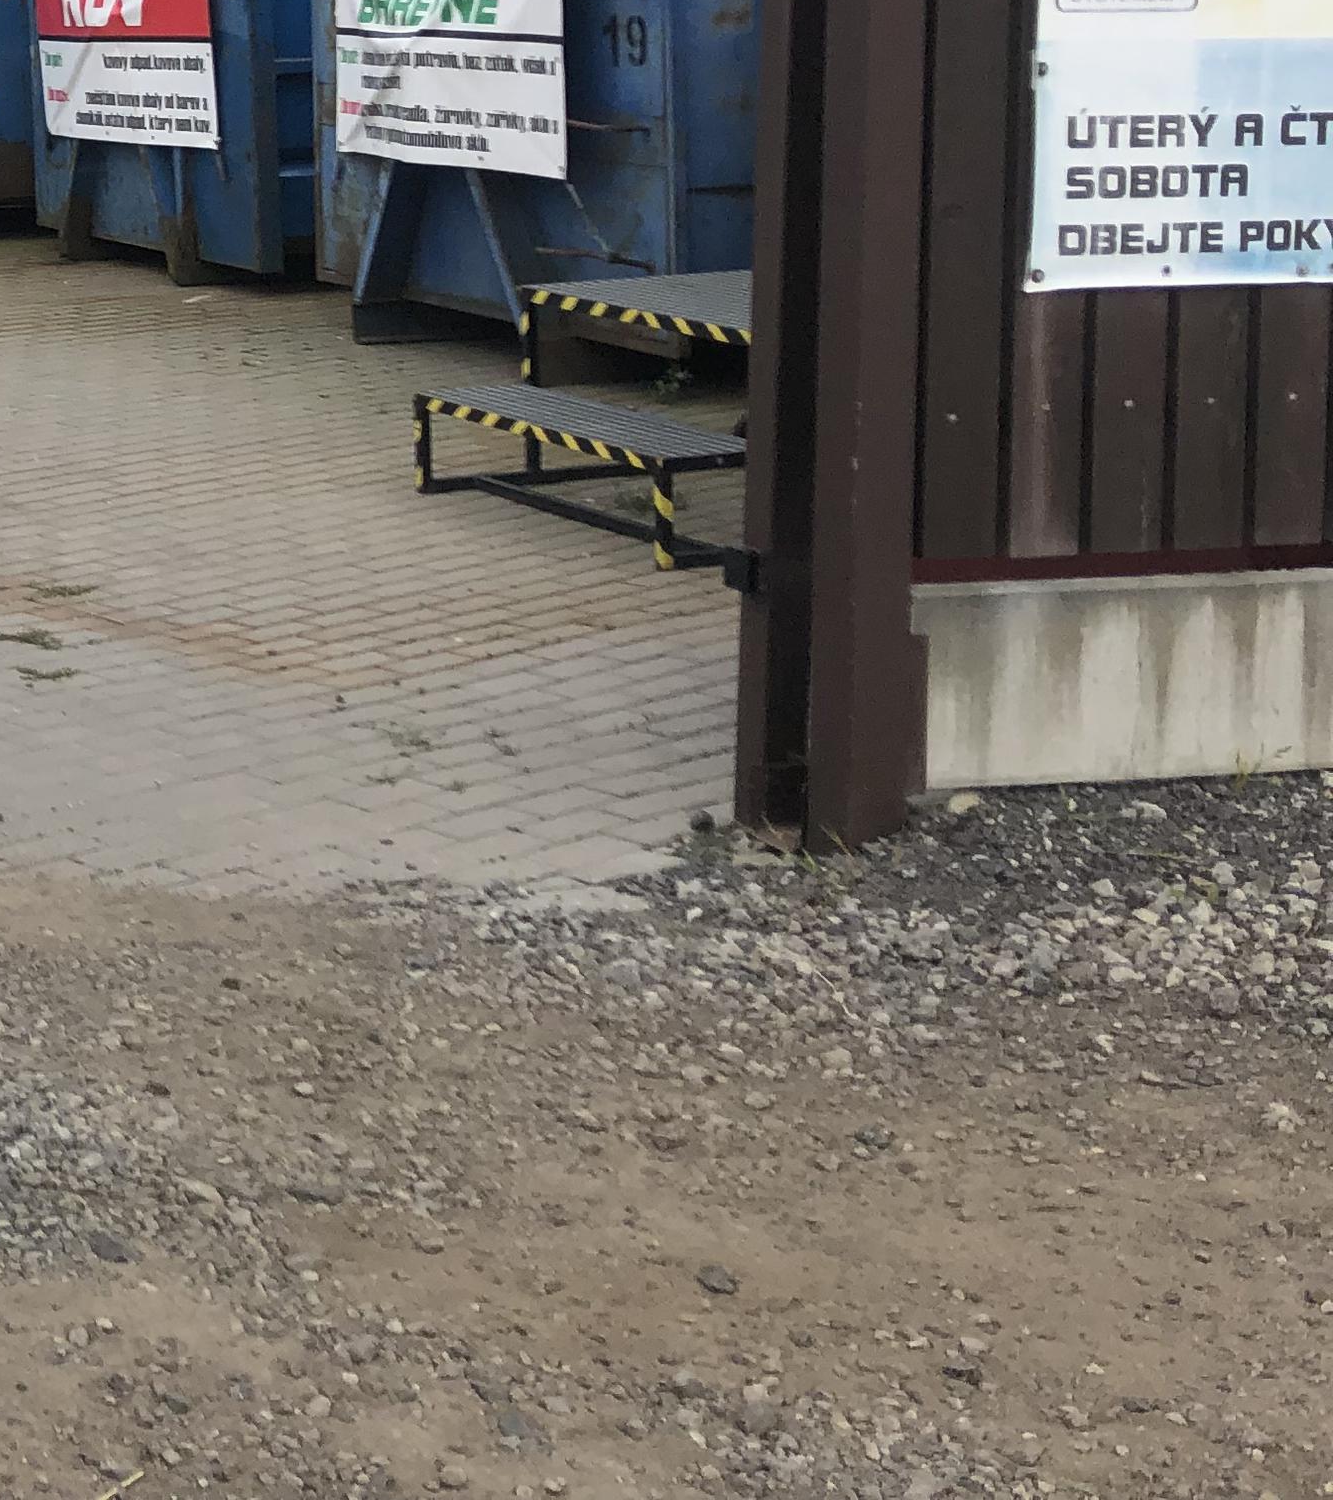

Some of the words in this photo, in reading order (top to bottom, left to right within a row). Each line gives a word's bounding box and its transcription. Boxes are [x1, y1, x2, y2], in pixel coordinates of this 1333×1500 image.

[603, 14, 648, 67] 19
[1067, 106, 1218, 149] ÚTERÝ
[1234, 113, 1263, 147] A
[1280, 105, 1333, 146] ČT
[1066, 164, 1248, 200] SOBOTA
